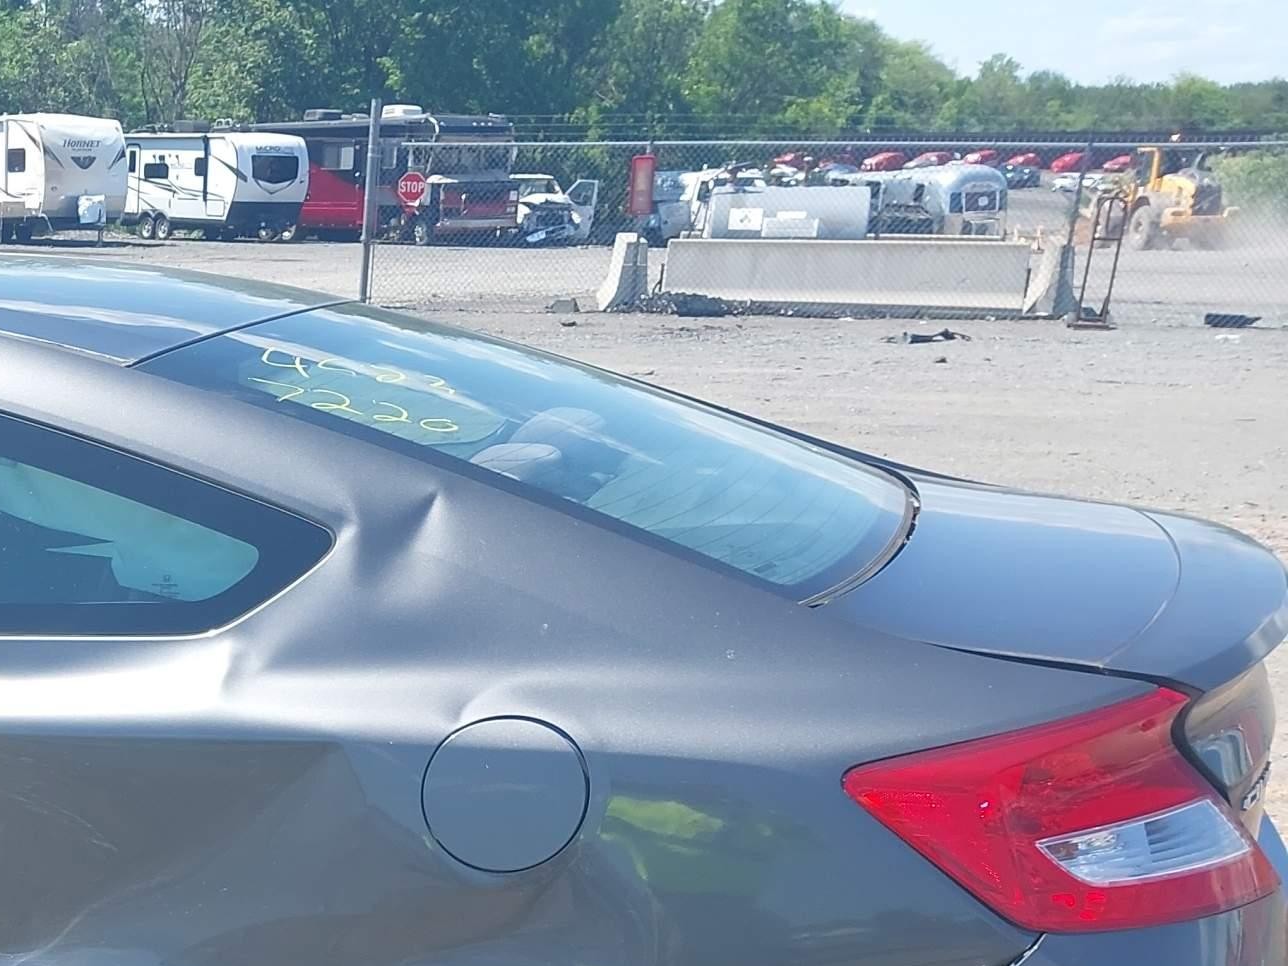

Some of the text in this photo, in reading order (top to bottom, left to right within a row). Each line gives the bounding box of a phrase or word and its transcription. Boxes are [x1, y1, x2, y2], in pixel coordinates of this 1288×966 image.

[63, 138, 101, 148] HORNET
[401, 181, 424, 193] STOP
[247, 376, 459, 432] 7220
